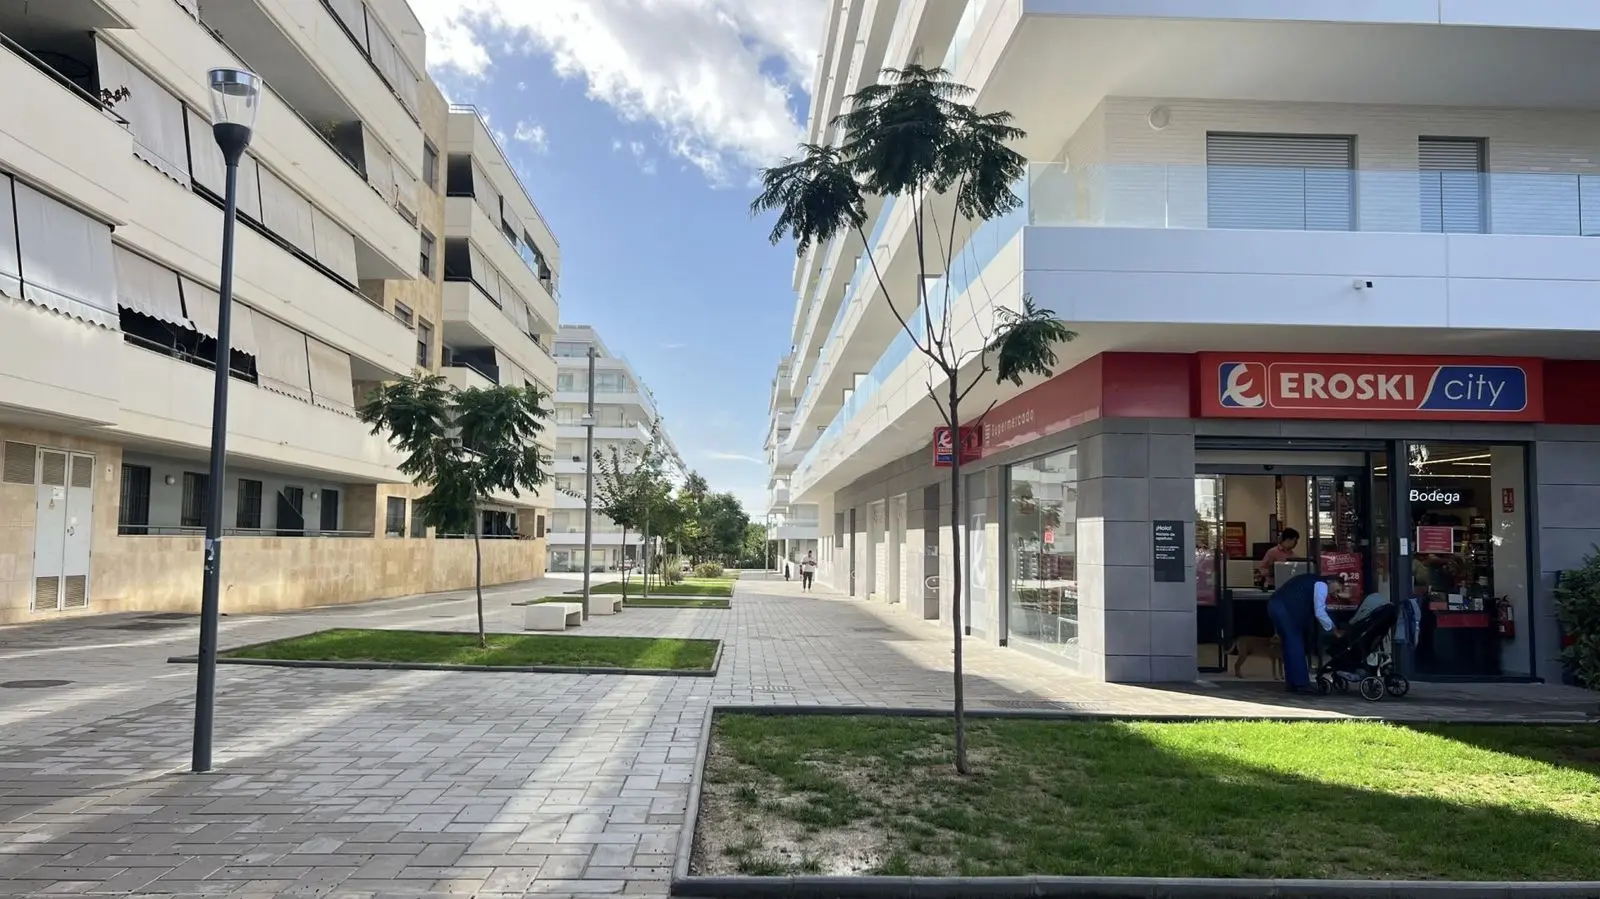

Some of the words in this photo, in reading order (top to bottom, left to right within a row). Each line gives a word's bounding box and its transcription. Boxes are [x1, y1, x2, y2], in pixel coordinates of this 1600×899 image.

[1280, 372, 1414, 401] EROSKI
[1444, 373, 1506, 407] city
[991, 408, 1035, 438] Supermercado
[1409, 489, 1460, 504] Bodega
